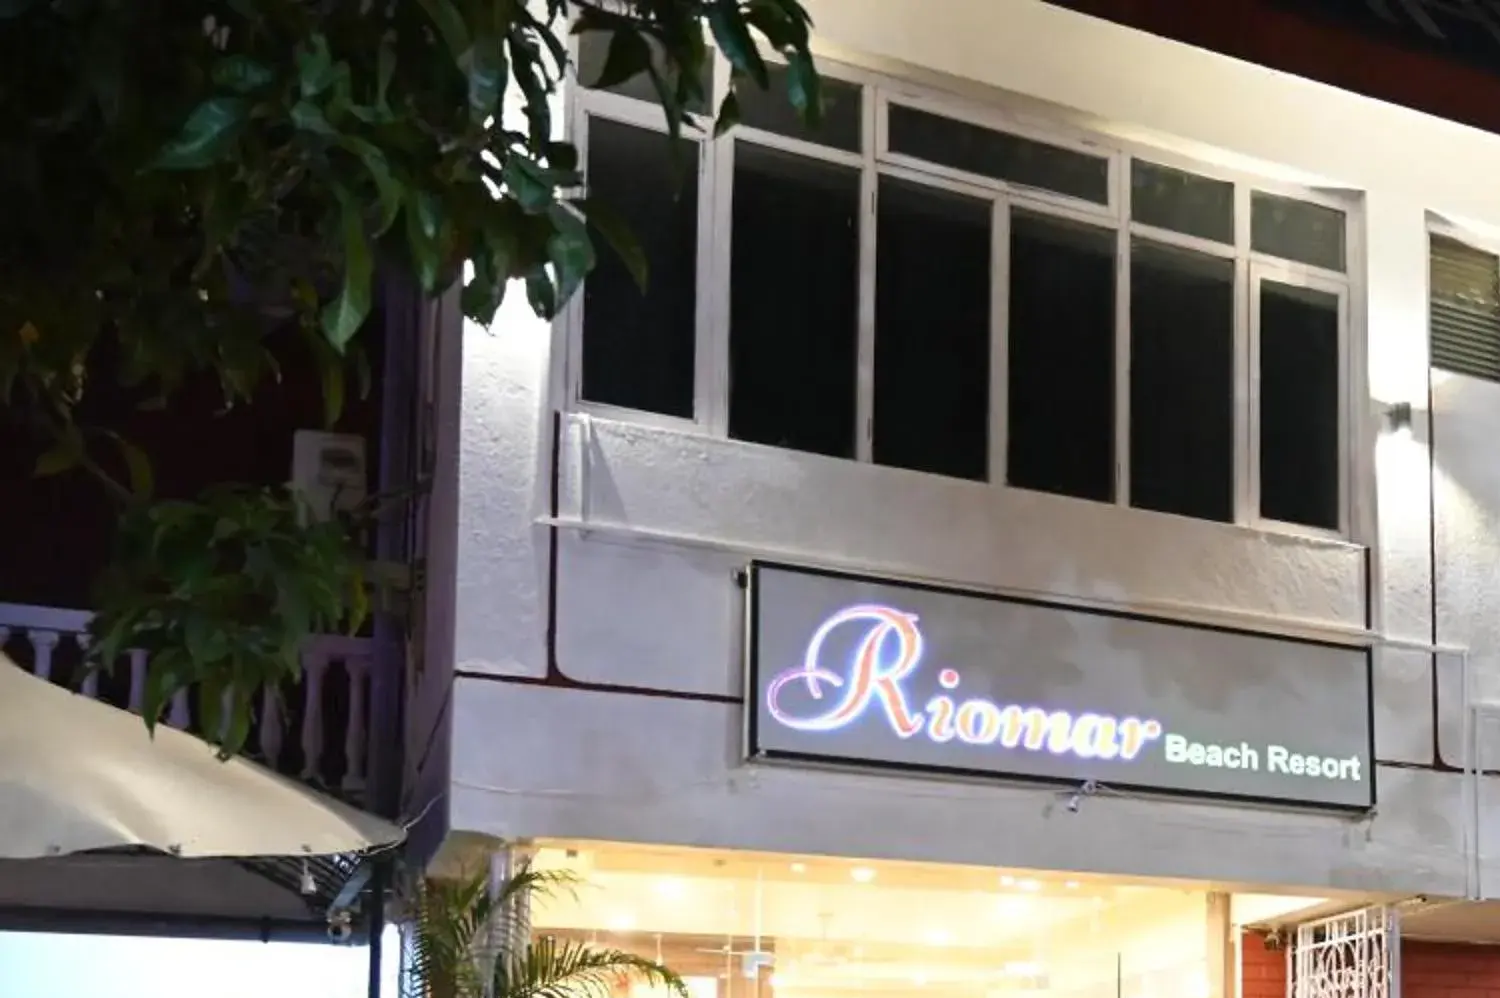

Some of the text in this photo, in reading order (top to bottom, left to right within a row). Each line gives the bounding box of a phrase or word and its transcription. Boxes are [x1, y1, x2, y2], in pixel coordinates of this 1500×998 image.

[767, 604, 1361, 782] Riomar Beach Resort
